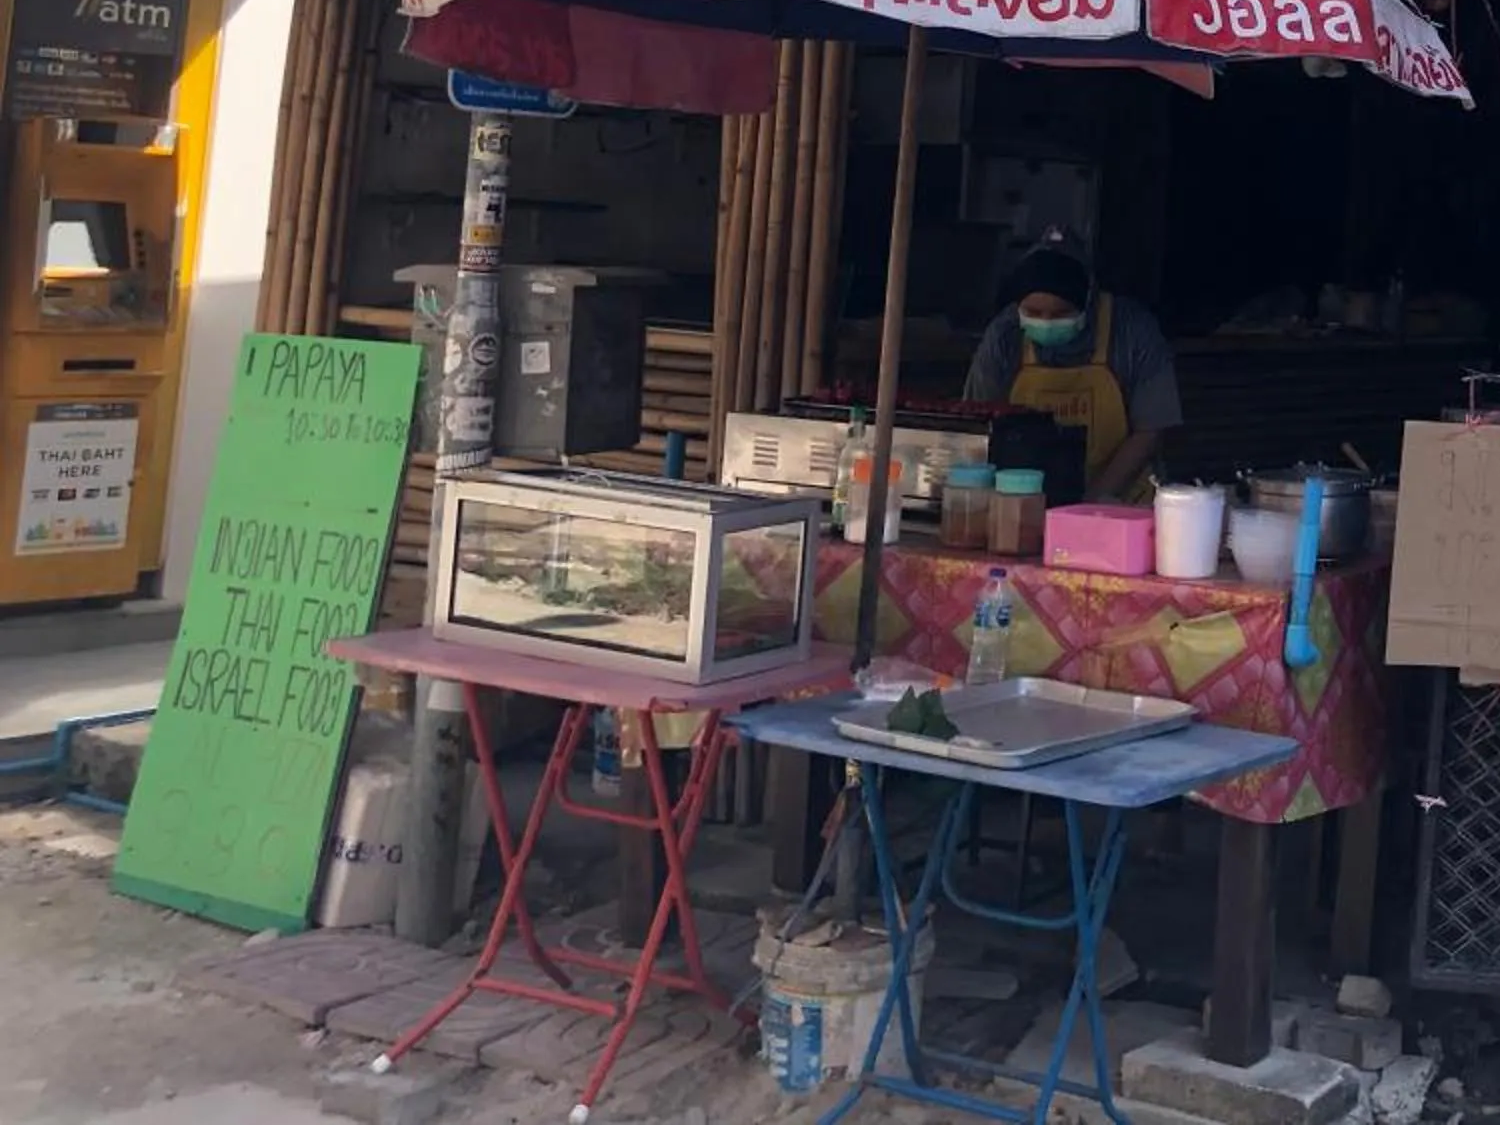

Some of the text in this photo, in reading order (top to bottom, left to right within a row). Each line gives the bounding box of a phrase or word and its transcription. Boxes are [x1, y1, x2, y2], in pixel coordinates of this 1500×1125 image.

[263, 340, 366, 404] PAPAYA
[39, 448, 125, 463] THAI BAHT
[58, 465, 102, 478] HERE
[210, 516, 307, 585] INDIAN
[221, 586, 285, 653] THAI
[173, 648, 271, 725] ISRAEL
